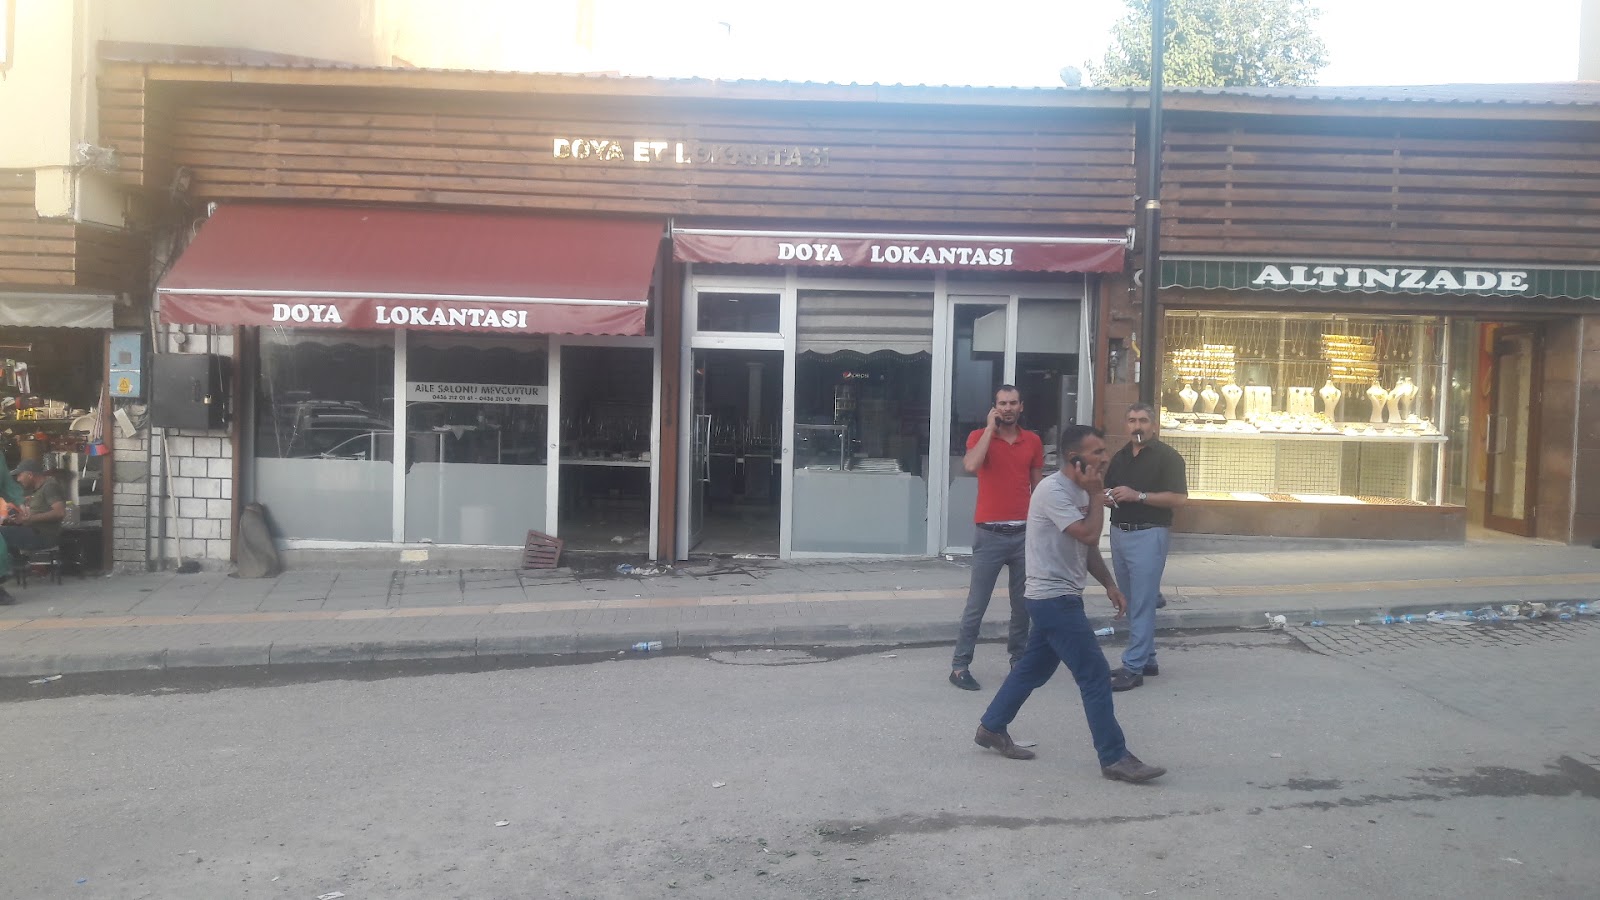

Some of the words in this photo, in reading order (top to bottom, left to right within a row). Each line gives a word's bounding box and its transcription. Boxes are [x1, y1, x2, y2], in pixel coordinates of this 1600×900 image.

[553, 138, 624, 161] DOYA
[633, 141, 668, 163] ET
[778, 243, 843, 261] DOYA
[871, 246, 1013, 265] LOKANTASI
[1252, 265, 1528, 291] ALTINZADE
[272, 304, 342, 323] DOYA
[376, 306, 527, 328] LOKANTASI
[438, 384, 477, 394] SALONU
[481, 386, 538, 396] MEVCUTTUR
